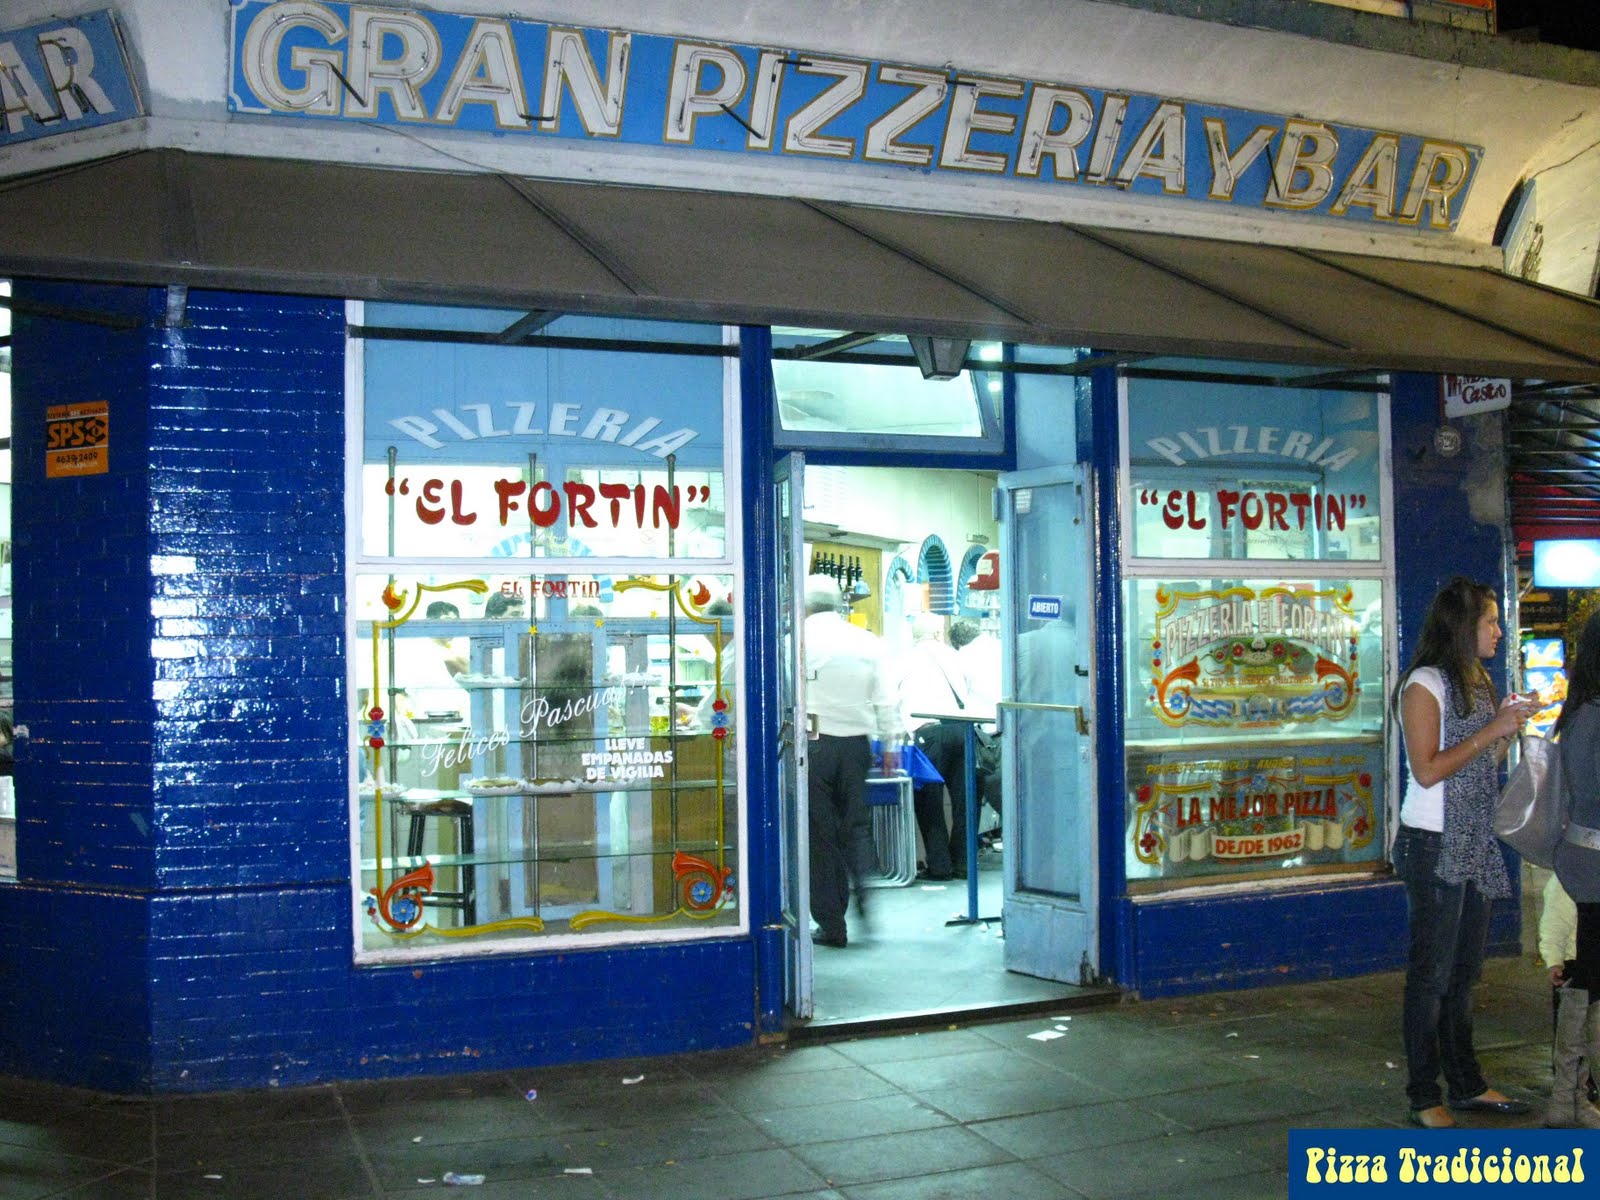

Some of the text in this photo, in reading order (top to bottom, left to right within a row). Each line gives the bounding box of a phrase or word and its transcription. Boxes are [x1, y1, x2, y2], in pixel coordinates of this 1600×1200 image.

[242, 3, 1476, 228] GRAN PIZZERIA Y BAR
[385, 401, 701, 459] PIZZERIA
[1147, 425, 1361, 472] PIZZERIA
[1031, 601, 1059, 614] ABIERTO
[1165, 600, 1252, 668] PIZZERIA
[1258, 600, 1280, 633] EL
[581, 751, 673, 765] EMPANADAS
[605, 738, 645, 751] LLEVE
[586, 765, 664, 780] DE VIGILIA
[1177, 788, 1337, 829] LA MEJOR PIZZA
[1215, 833, 1302, 855] DESDE 1962
